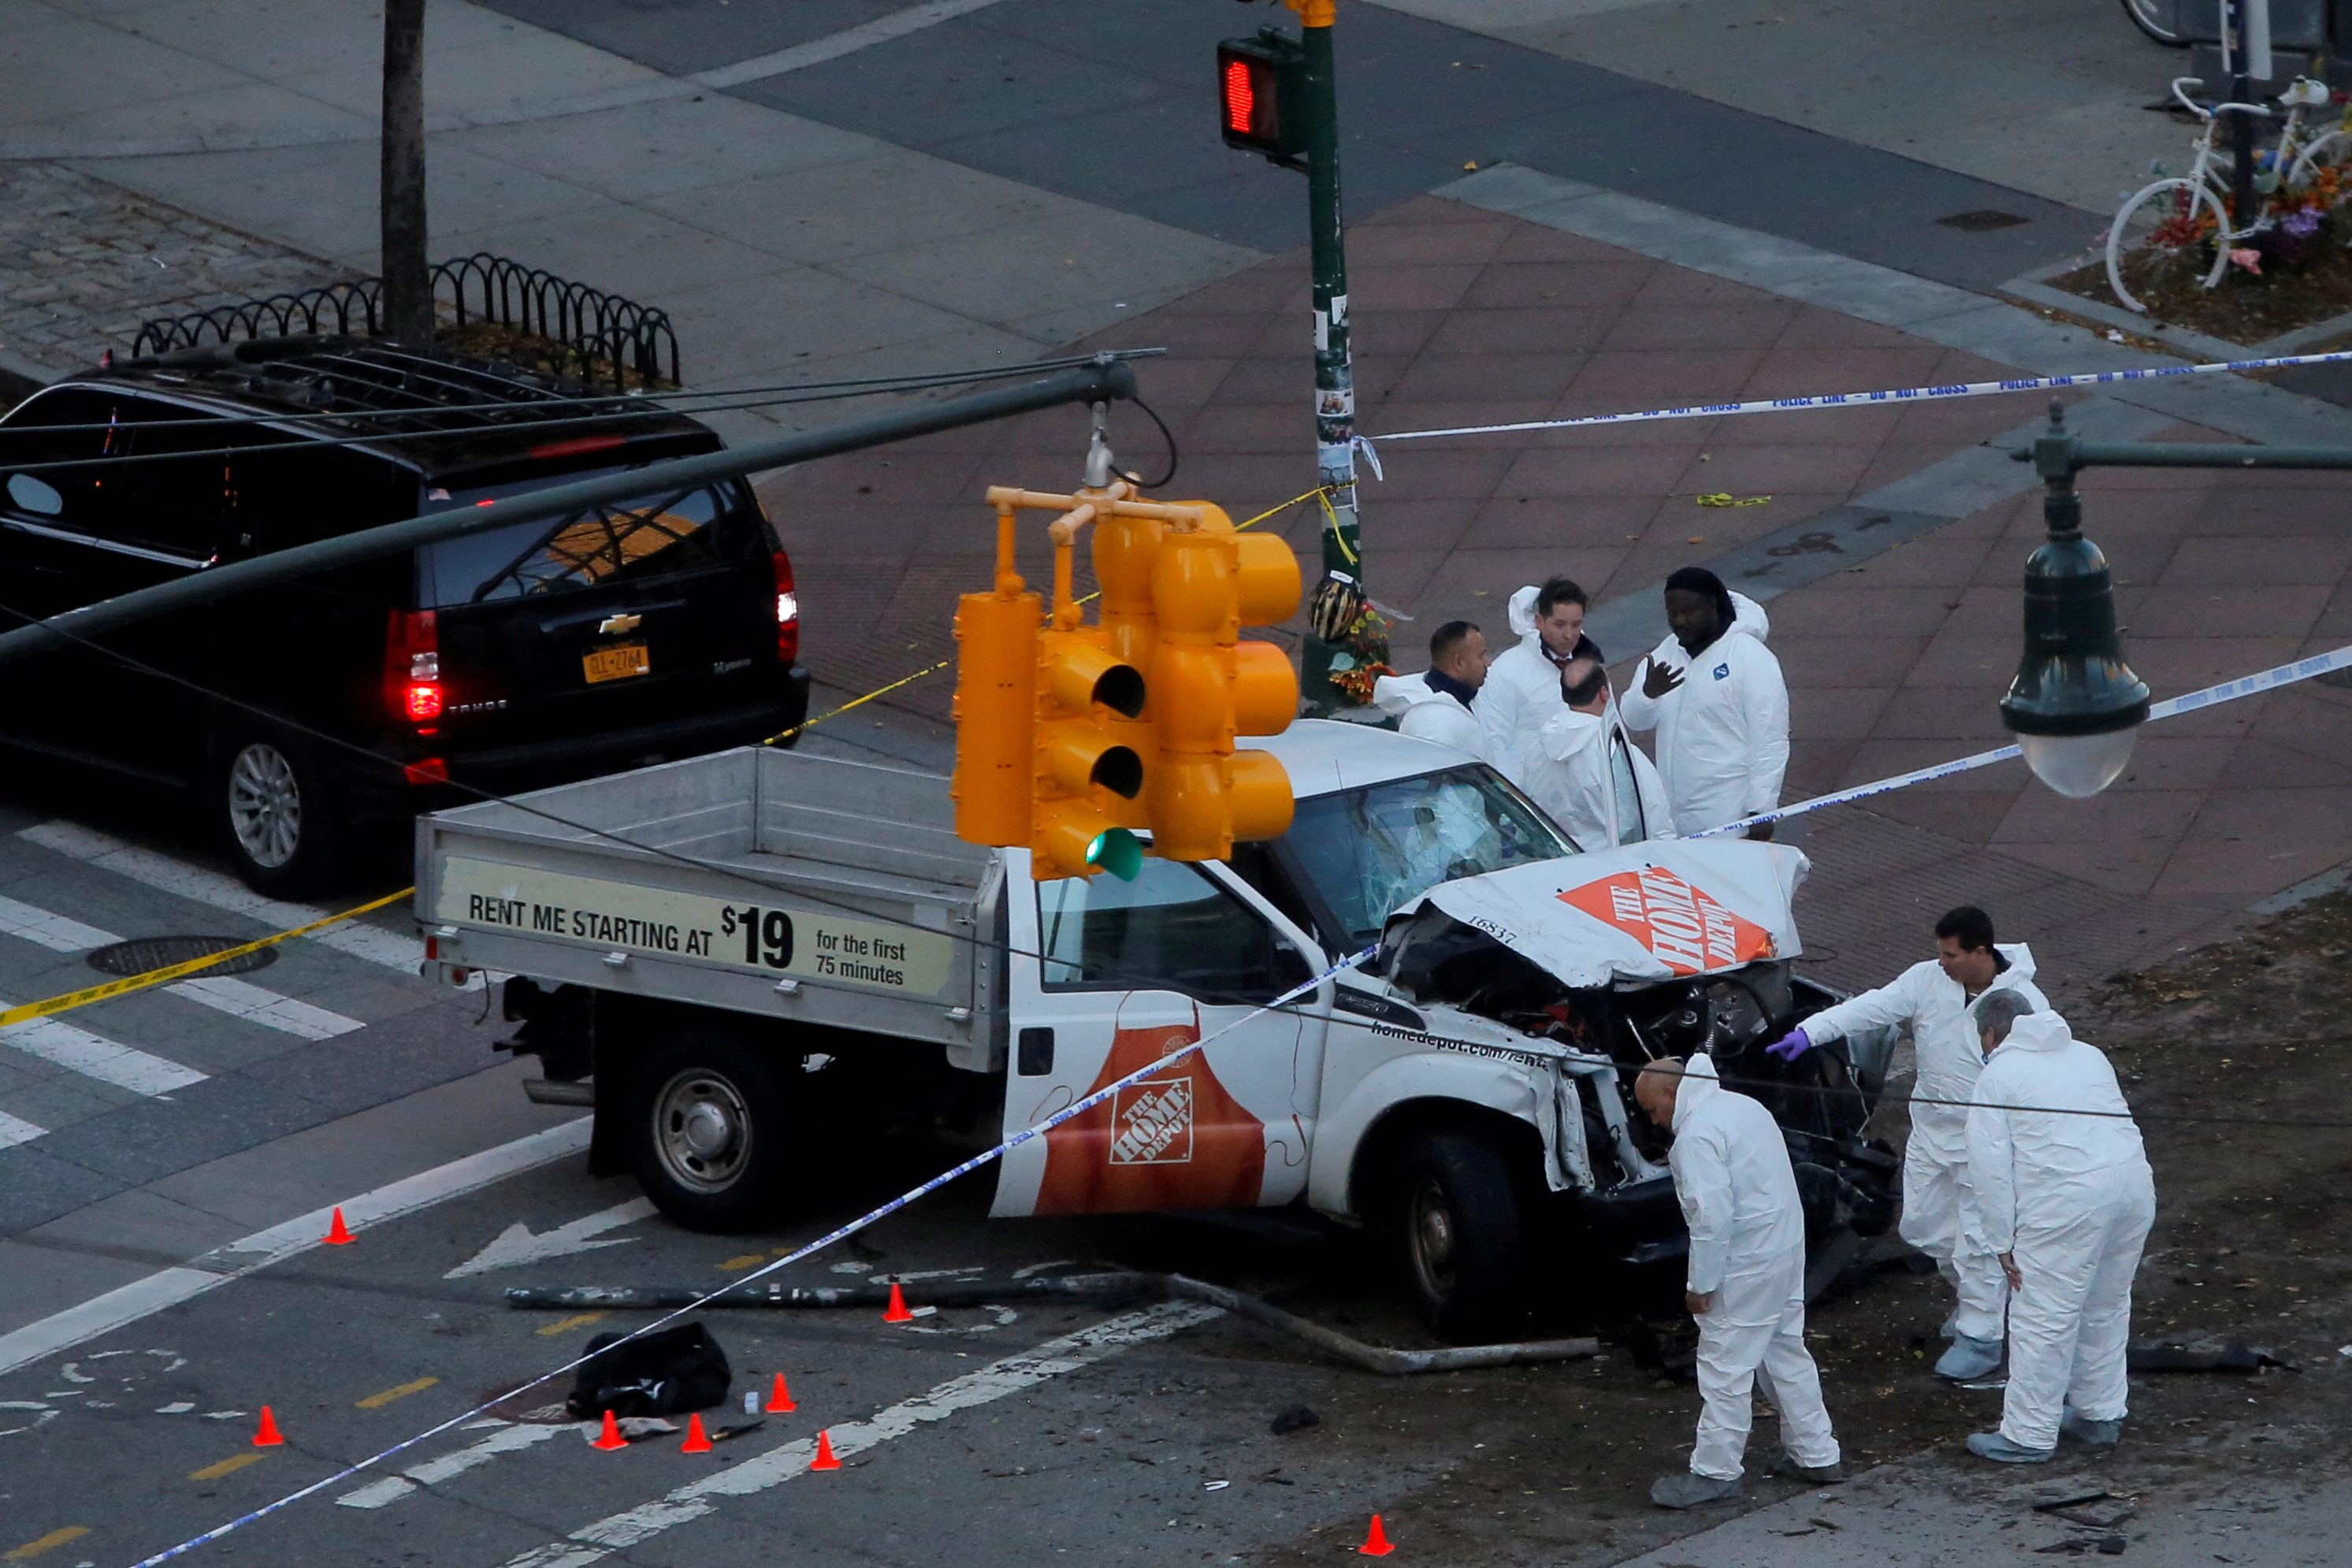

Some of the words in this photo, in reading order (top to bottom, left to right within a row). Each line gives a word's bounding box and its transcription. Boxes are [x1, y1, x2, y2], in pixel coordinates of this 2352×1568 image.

[1822, 394, 1847, 404] LINE
[1999, 378, 2040, 391] POLICE
[2049, 376, 2074, 386] LINE
[1610, 885, 1645, 923] THE
[1637, 868, 1705, 972] HOME
[470, 894, 526, 927] RENT
[533, 904, 566, 934] ME
[572, 910, 678, 953] STARTING
[685, 928, 713, 957] AT
[721, 905, 794, 969] $19
[816, 929, 839, 950] for
[843, 934, 868, 955] the
[873, 938, 906, 961] first
[1468, 916, 1518, 945] 16837
[816, 954, 835, 975] 75
[840, 960, 904, 986] minutes
[1113, 1082, 1191, 1163] HOME
[1122, 1091, 1157, 1124] THE
[1142, 1109, 1191, 1161] DEPOT
